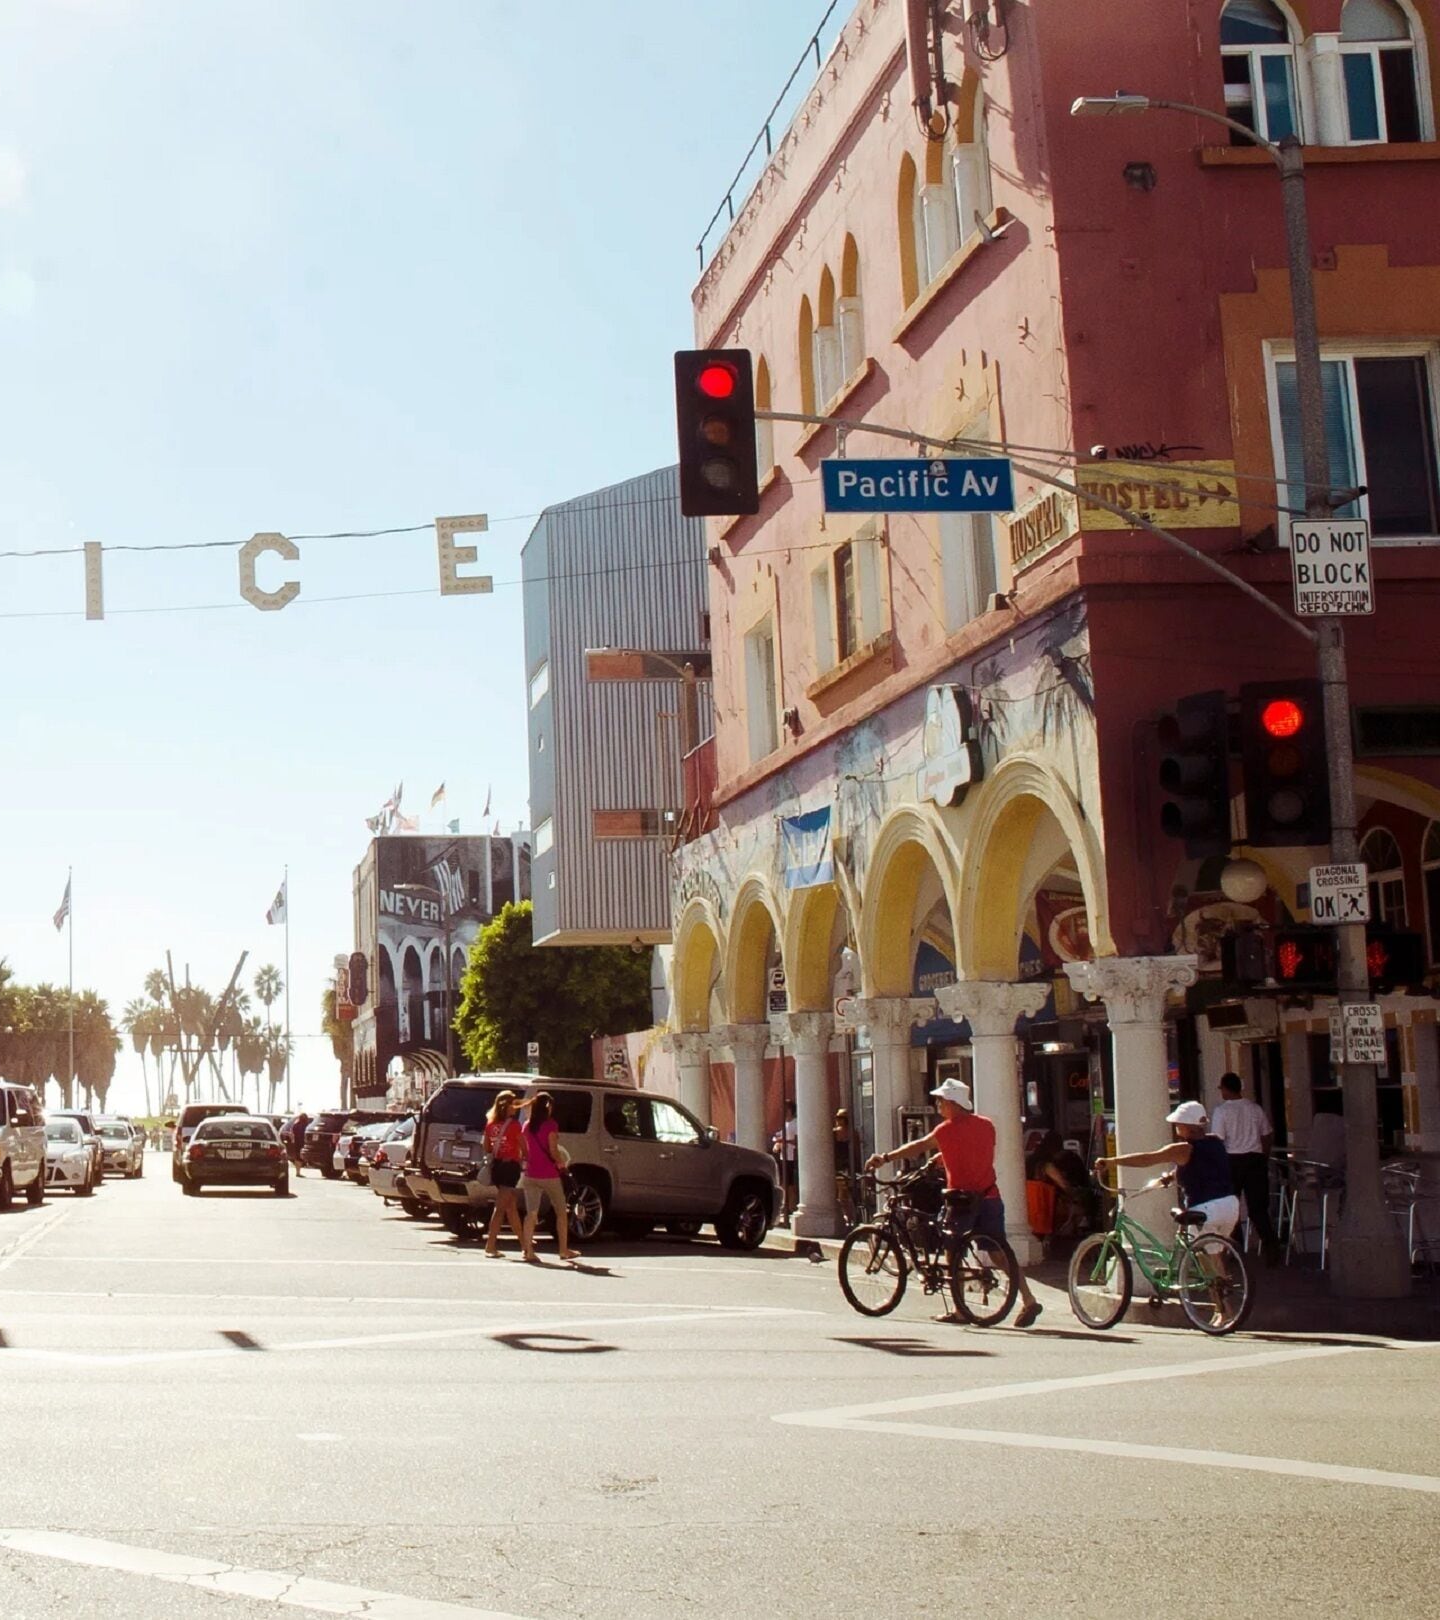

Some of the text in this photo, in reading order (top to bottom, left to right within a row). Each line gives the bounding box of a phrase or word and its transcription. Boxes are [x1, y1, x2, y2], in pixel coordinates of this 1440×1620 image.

[837, 469, 999, 498] Pacific Av
[1081, 477, 1190, 511] HOSTEL
[1011, 492, 1063, 564] HOSTEL
[1296, 531, 1365, 553] DO NOT
[1297, 563, 1368, 584] BLOCK
[1315, 866, 1358, 877] DIAGONAL
[1316, 875, 1360, 887] CROSSING
[379, 889, 439, 922] NEVER
[1314, 896, 1336, 918] OK
[1348, 1006, 1377, 1017] CROSS
[1358, 1017, 1368, 1026] ON
[1351, 1026, 1376, 1037] WALK
[1349, 1037, 1382, 1048] SIGNAL
[1354, 1050, 1377, 1061] ONLY
